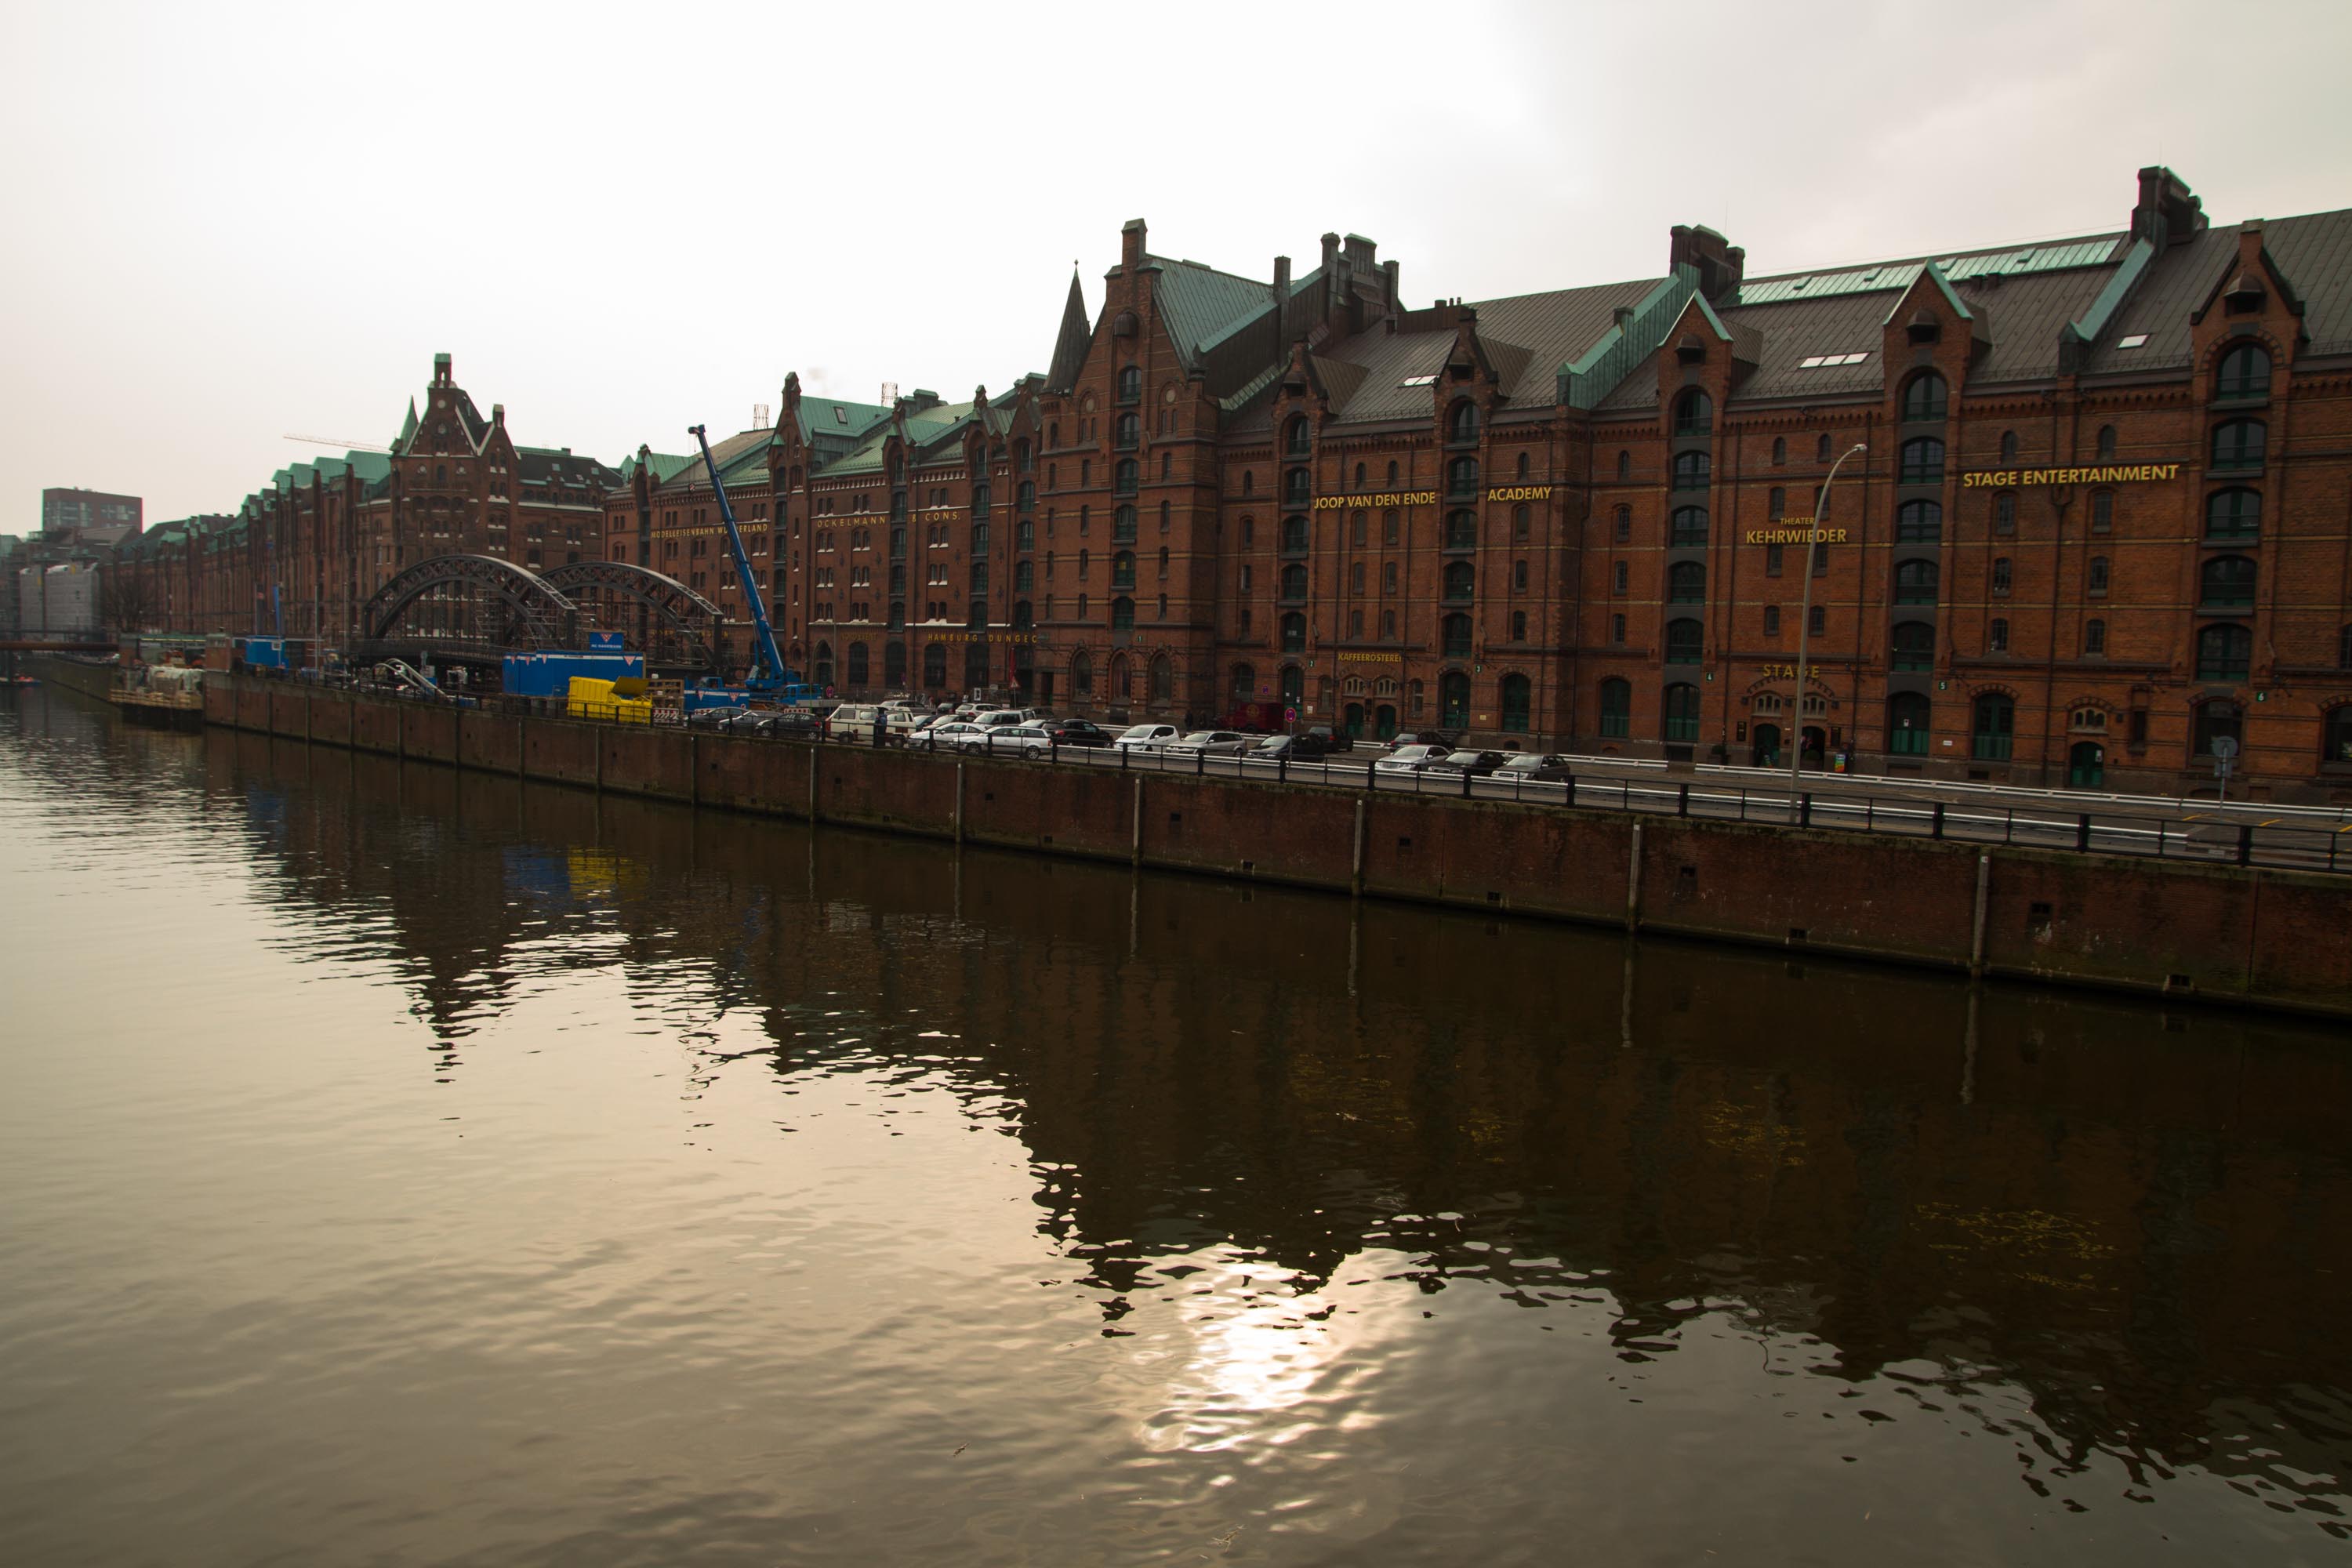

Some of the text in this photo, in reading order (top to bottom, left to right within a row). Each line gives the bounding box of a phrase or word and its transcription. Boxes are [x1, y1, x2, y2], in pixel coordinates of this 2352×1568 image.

[1963, 463, 2180, 488] STAGE ENTERTAINMENT
[1314, 486, 1552, 510] JOOP VAN DEN ENDE ACADEMY
[817, 515, 886, 528] OCKELMANN
[1746, 528, 1847, 544] KEHRWIEDER
[927, 633, 978, 642] HAMBURG
